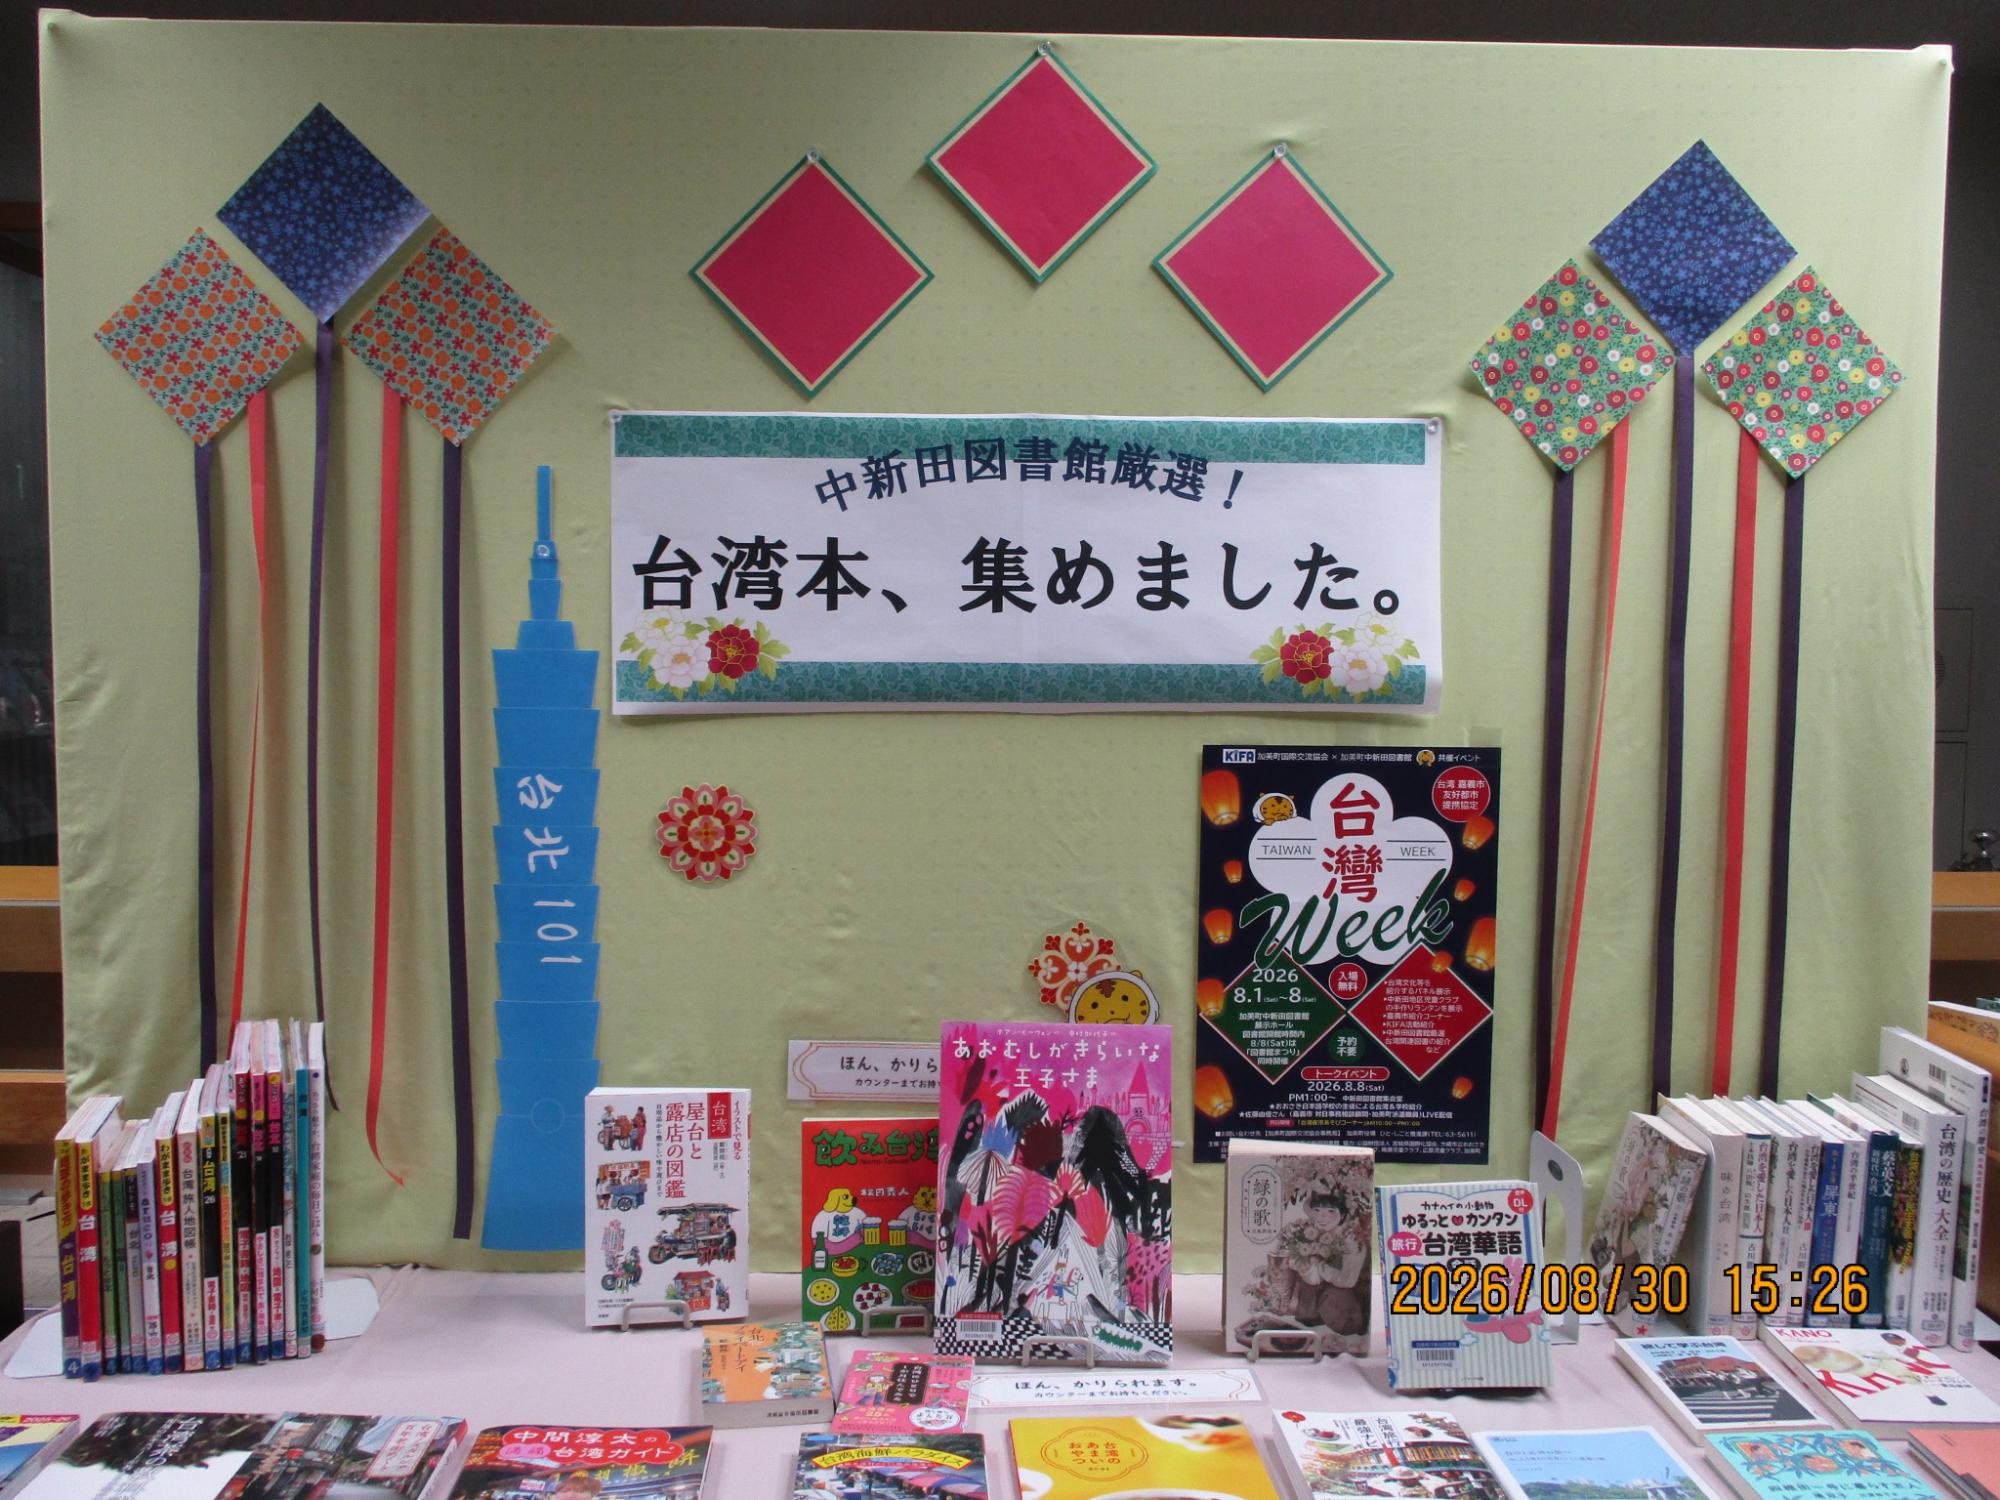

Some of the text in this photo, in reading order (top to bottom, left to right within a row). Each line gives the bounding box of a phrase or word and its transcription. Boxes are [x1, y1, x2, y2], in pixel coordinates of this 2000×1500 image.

[813, 435, 1246, 515] 中新田図書館厳選！
[632, 536, 1401, 617] 台湾本、集めました。
[1340, 752, 1413, 762] 加美町中新田図書館
[1442, 790, 1479, 800] 友好都市
[1262, 845, 1312, 856] TAIWAN
[1400, 846, 1436, 857] WEEK
[1239, 867, 1454, 969] Week
[1252, 969, 1299, 983] 2026
[1337, 1036, 1358, 1047] 予約
[952, 1036, 1161, 1063] あおむしがきらいな
[1336, 1047, 1358, 1057] 不要
[1013, 1066, 1100, 1089] 王子さま
[1315, 1069, 1377, 1079] トークイベント
[711, 1101, 727, 1134] 台湾
[687, 1101, 705, 1160] 屋台と
[733, 1100, 742, 1161] イラストで見る
[665, 1102, 686, 1199] 露店の図鑑
[1879, 1150, 1897, 1198] 蔡英文
[1933, 1123, 1957, 1242] 台湾の歴史大全
[1717, 1171, 1733, 1224] 味の台湾
[1420, 1200, 1495, 1211] カナヘイの小動物
[1402, 1213, 1518, 1229] ゆるっと カンタン
[1391, 1237, 1418, 1251] 旅行
[1422, 1230, 1523, 1257] 台湾華語
[1775, 1328, 1832, 1338] KANO
[1015, 1377, 1197, 1390] ほん、かりられます。
[513, 1431, 657, 1446] 中間淳太の
[553, 1446, 674, 1460] 台湾ガイド
